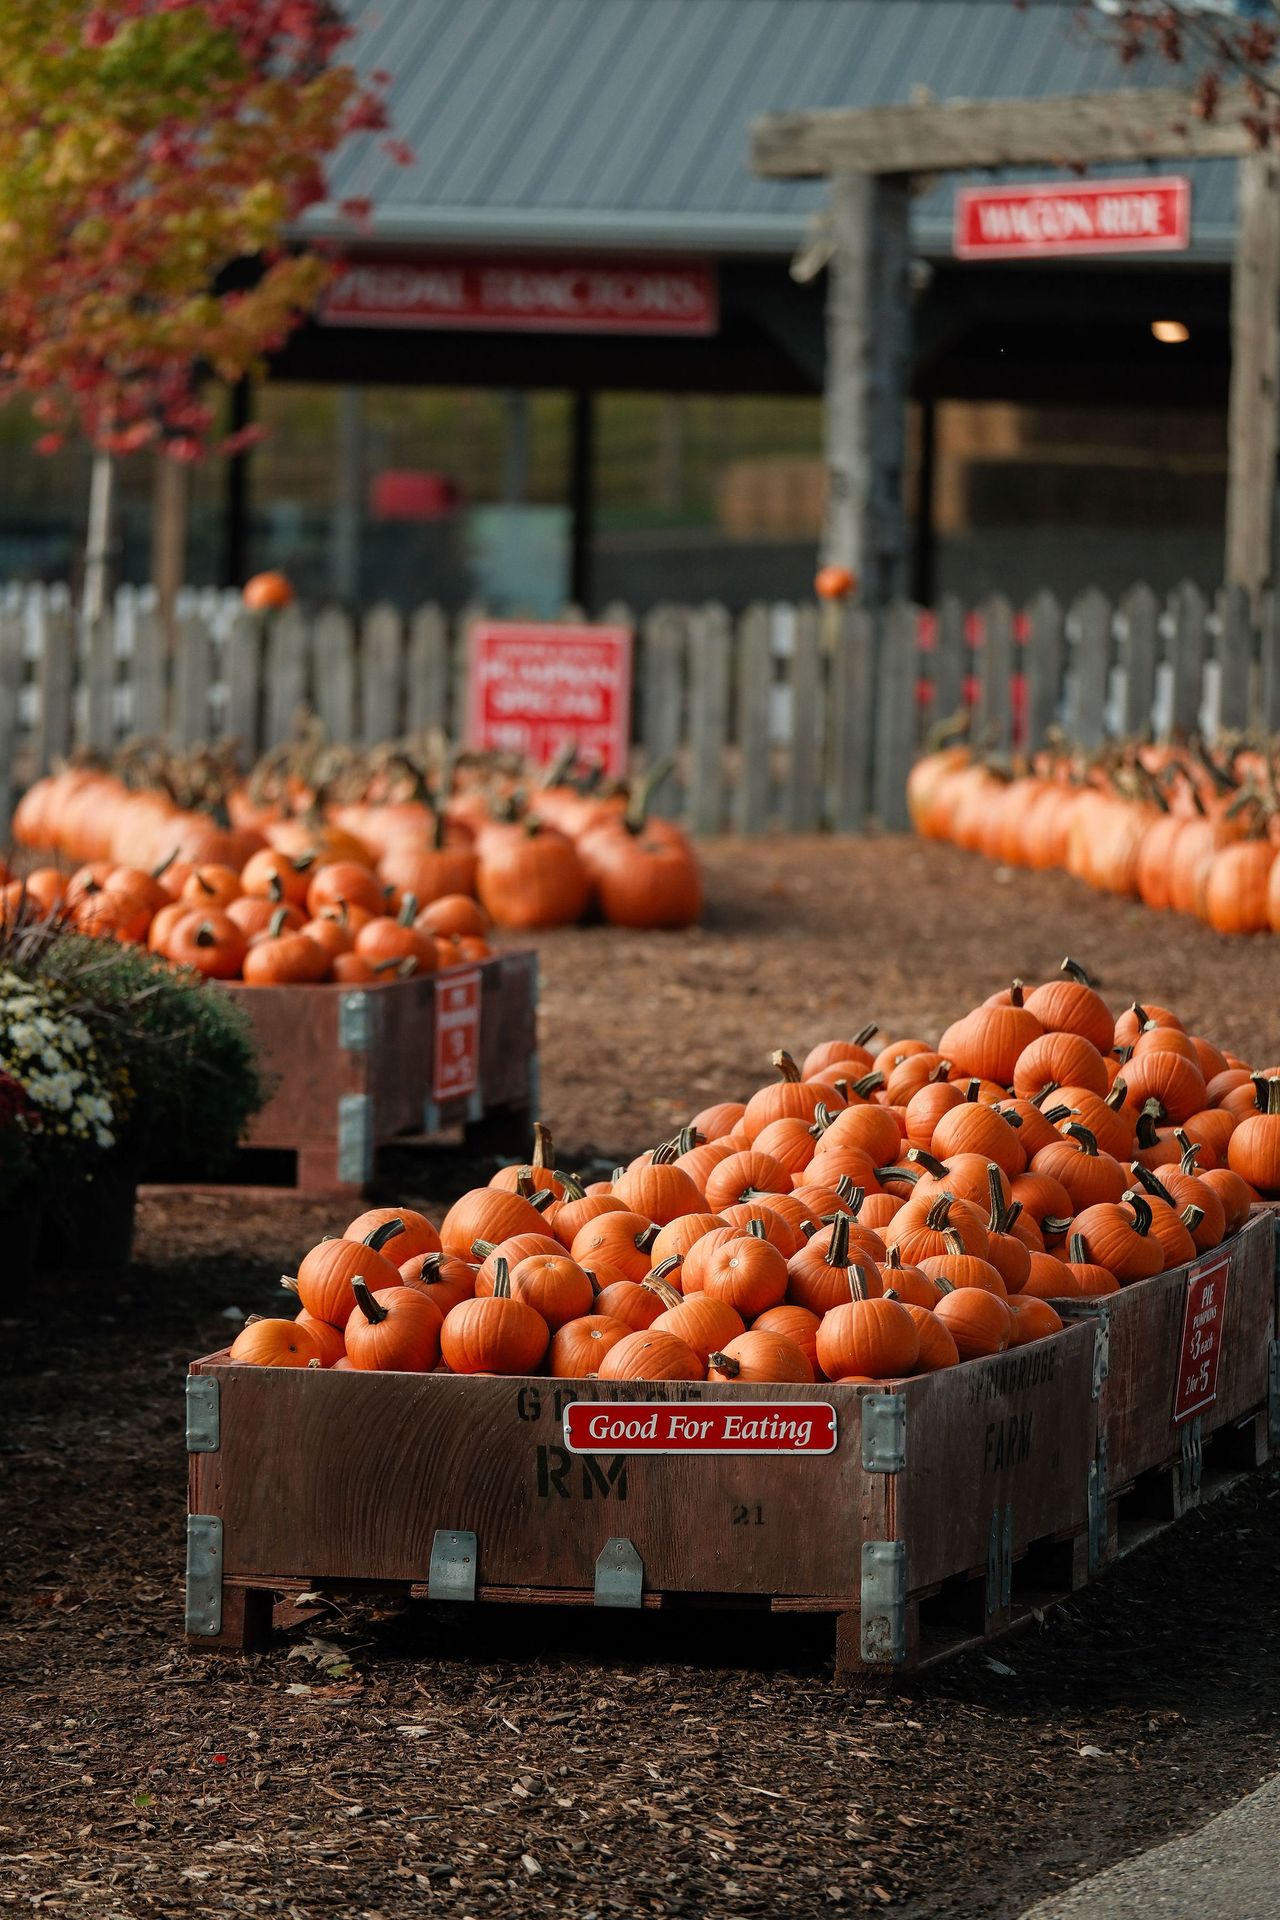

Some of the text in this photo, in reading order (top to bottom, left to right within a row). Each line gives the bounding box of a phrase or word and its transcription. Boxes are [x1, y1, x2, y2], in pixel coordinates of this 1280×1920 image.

[978, 192, 1165, 242] WAGON RIDE
[1201, 1283, 1215, 1309] PIE
[1192, 1305, 1217, 1330] PUMPKINS
[1200, 1332, 1214, 1355] each
[588, 1413, 813, 1447] Good For Eating
[984, 1411, 1033, 1474] FARM
[536, 1445, 628, 1500] RM
[732, 1504, 764, 1525] 21
